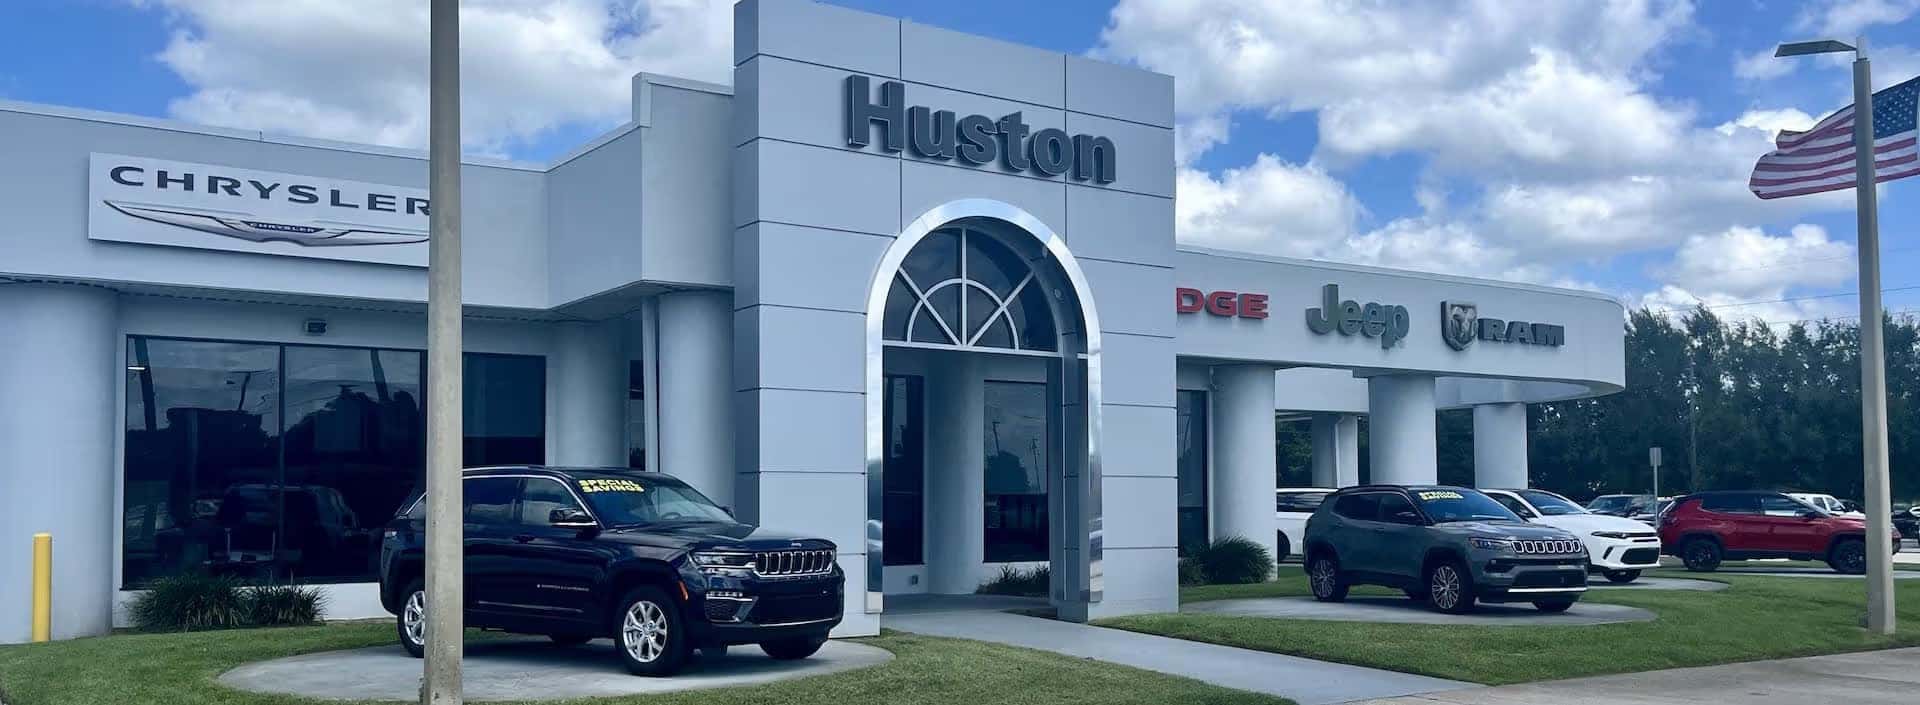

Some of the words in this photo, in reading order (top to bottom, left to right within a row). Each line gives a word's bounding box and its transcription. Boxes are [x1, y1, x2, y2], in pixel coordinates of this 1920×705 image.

[846, 75, 1116, 184] Huston
[109, 165, 430, 216] CHRYSLER
[1305, 283, 1410, 350] Jeep
[1477, 318, 1565, 346] RAM
[579, 479, 640, 487] SPECIAL
